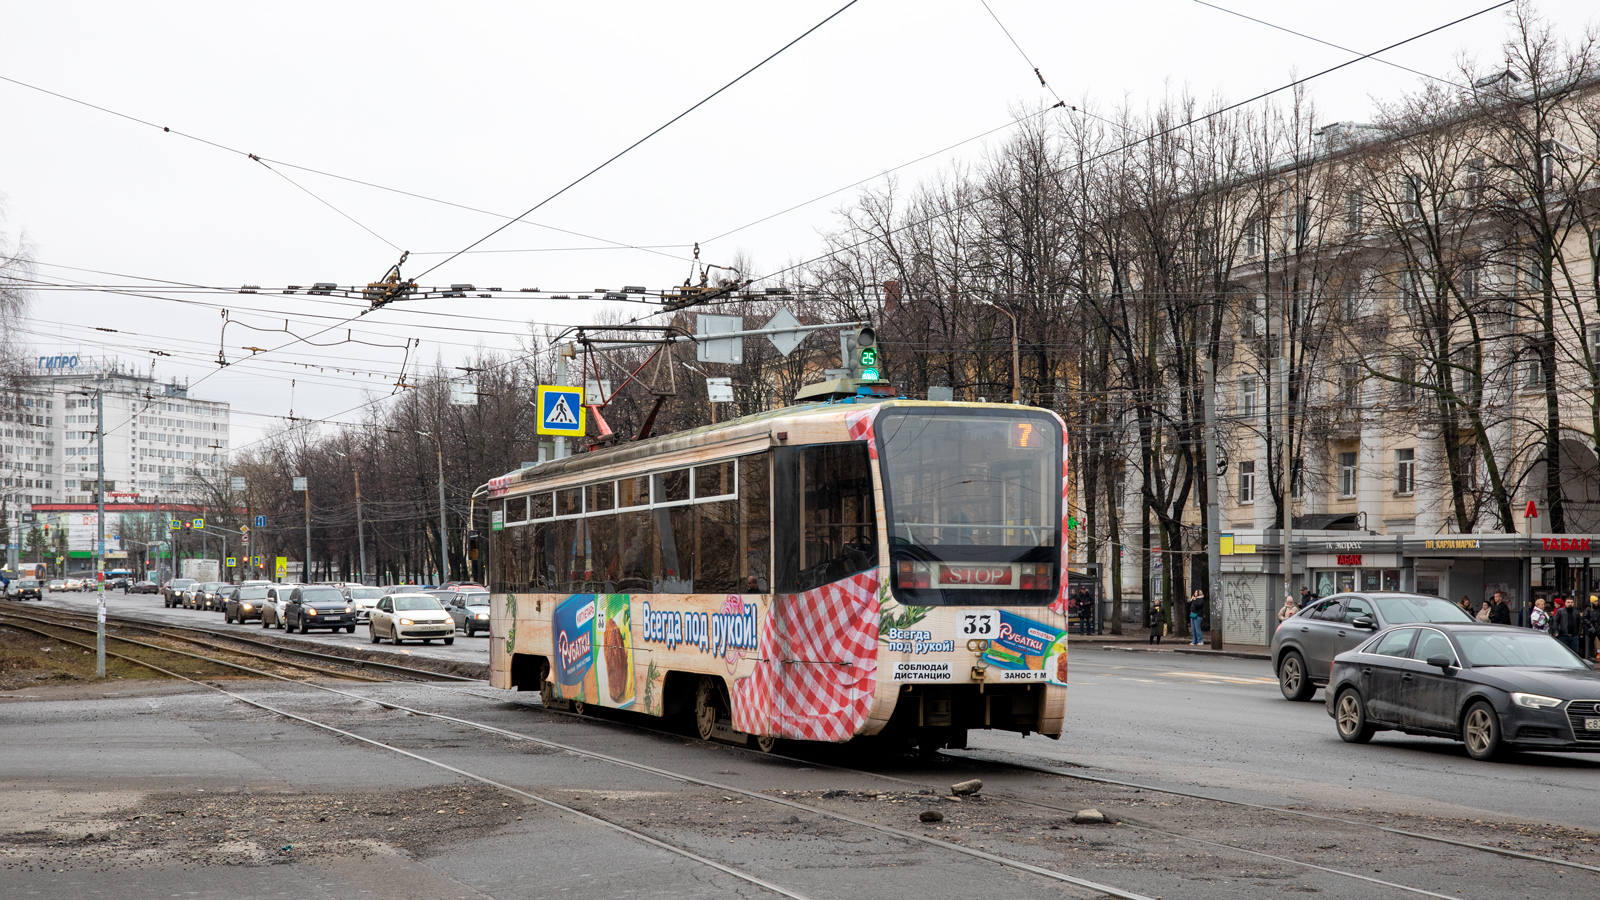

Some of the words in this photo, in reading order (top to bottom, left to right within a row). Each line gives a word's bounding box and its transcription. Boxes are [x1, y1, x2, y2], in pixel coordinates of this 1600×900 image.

[38, 355, 78, 369] ГИПРО
[862, 352, 875, 365] 25
[1018, 423, 1032, 447] 7
[1436, 540, 1455, 549] КАРЛА
[1455, 540, 1480, 549] МАРКСА
[1540, 538, 1591, 551] ТАБАК
[1336, 555, 1362, 566] ТАБАК
[949, 567, 1004, 584] STOP
[643, 601, 682, 649] Всегда
[684, 612, 709, 652] под
[712, 603, 757, 656] рукой!
[964, 615, 991, 634] 33
[889, 628, 931, 641] Всегда
[889, 642, 912, 653] под
[915, 640, 954, 654] рукой!
[898, 663, 948, 671] СОБЛЮДАЙ
[894, 672, 951, 680] ДИСТАНЦИЮ
